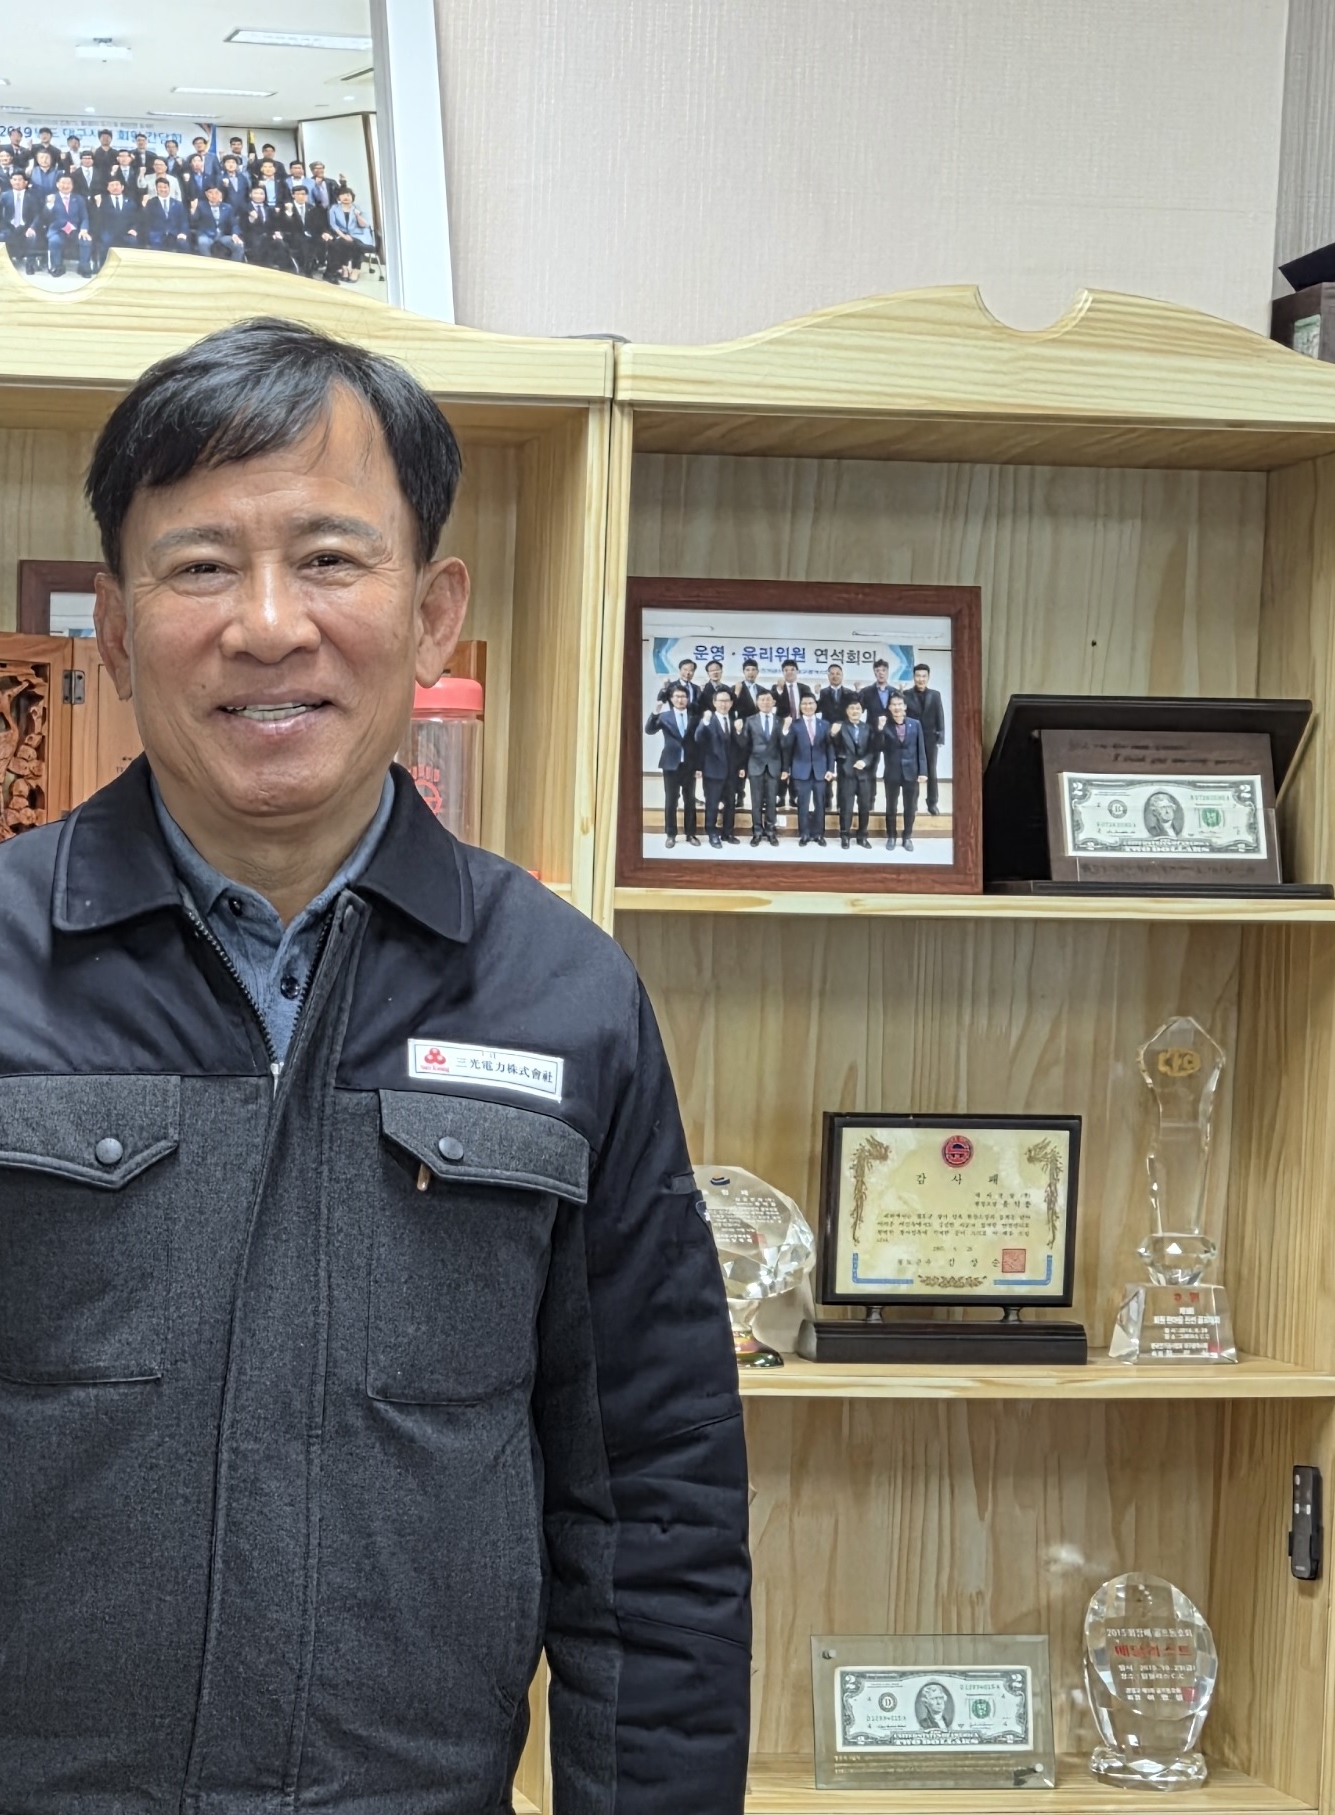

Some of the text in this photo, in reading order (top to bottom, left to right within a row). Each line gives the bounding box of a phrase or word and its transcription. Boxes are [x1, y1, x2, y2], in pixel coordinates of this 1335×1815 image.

[693, 645, 725, 661] 운영
[741, 646, 807, 663] 윤리위원
[814, 647, 878, 665] 연석회의
[1072, 782, 1083, 796] 2
[1239, 784, 1252, 798] 2
[845, 1674, 856, 1689] 2
[1011, 1673, 1023, 1688] 2
